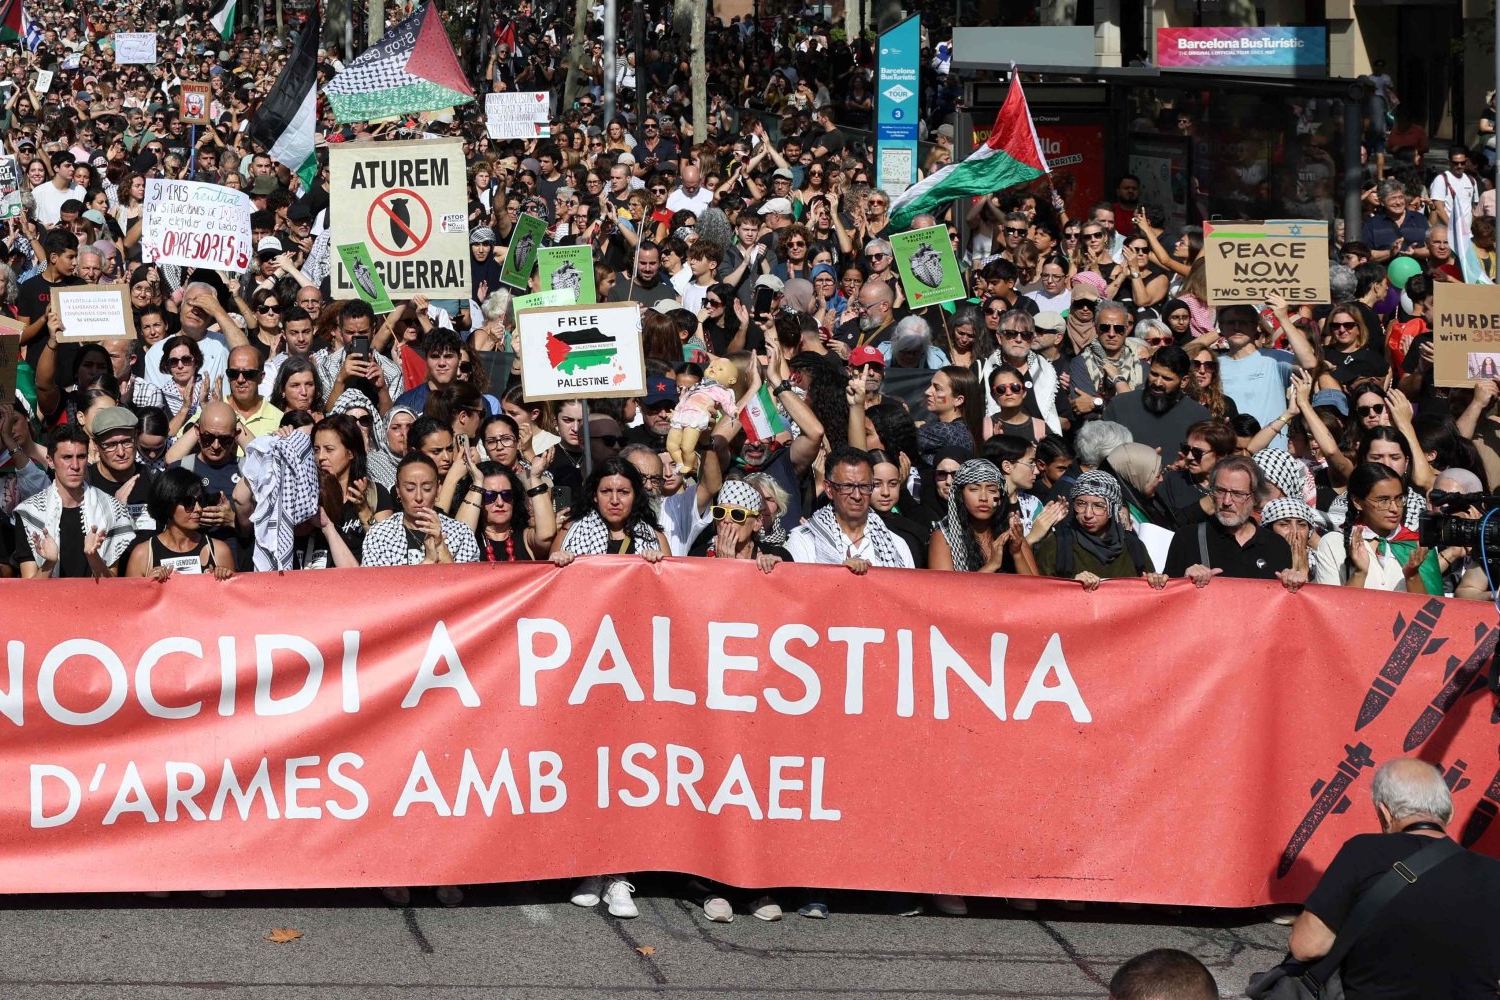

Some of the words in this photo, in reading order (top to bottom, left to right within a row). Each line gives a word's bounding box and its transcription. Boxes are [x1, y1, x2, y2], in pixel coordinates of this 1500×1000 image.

[1178, 38, 1240, 49] Barcelona
[1241, 38, 1304, 48] BusTurístic
[182, 85, 209, 93] WANTED
[894, 110, 901, 118] 3
[350, 158, 449, 190] ATUREM
[152, 183, 162, 200] SI
[192, 187, 242, 207] neutral
[147, 203, 157, 213] EN
[208, 207, 218, 217] DE
[206, 221, 214, 229] el
[162, 230, 236, 267] OPRESORES
[1218, 241, 1306, 259] PEACE
[337, 262, 354, 289] L
[373, 259, 465, 290] GUERRA!
[1234, 261, 1299, 277] NOW
[1212, 288, 1240, 297] TWO
[1245, 287, 1317, 299] STATES
[557, 315, 599, 328] FREE
[557, 376, 609, 388] PALESTINE
[400, 619, 481, 710] A
[516, 614, 1093, 723] PALESTINA
[29, 752, 369, 829] D'ARMES
[392, 747, 568, 817] AMB
[597, 742, 842, 821] ISRAEL
